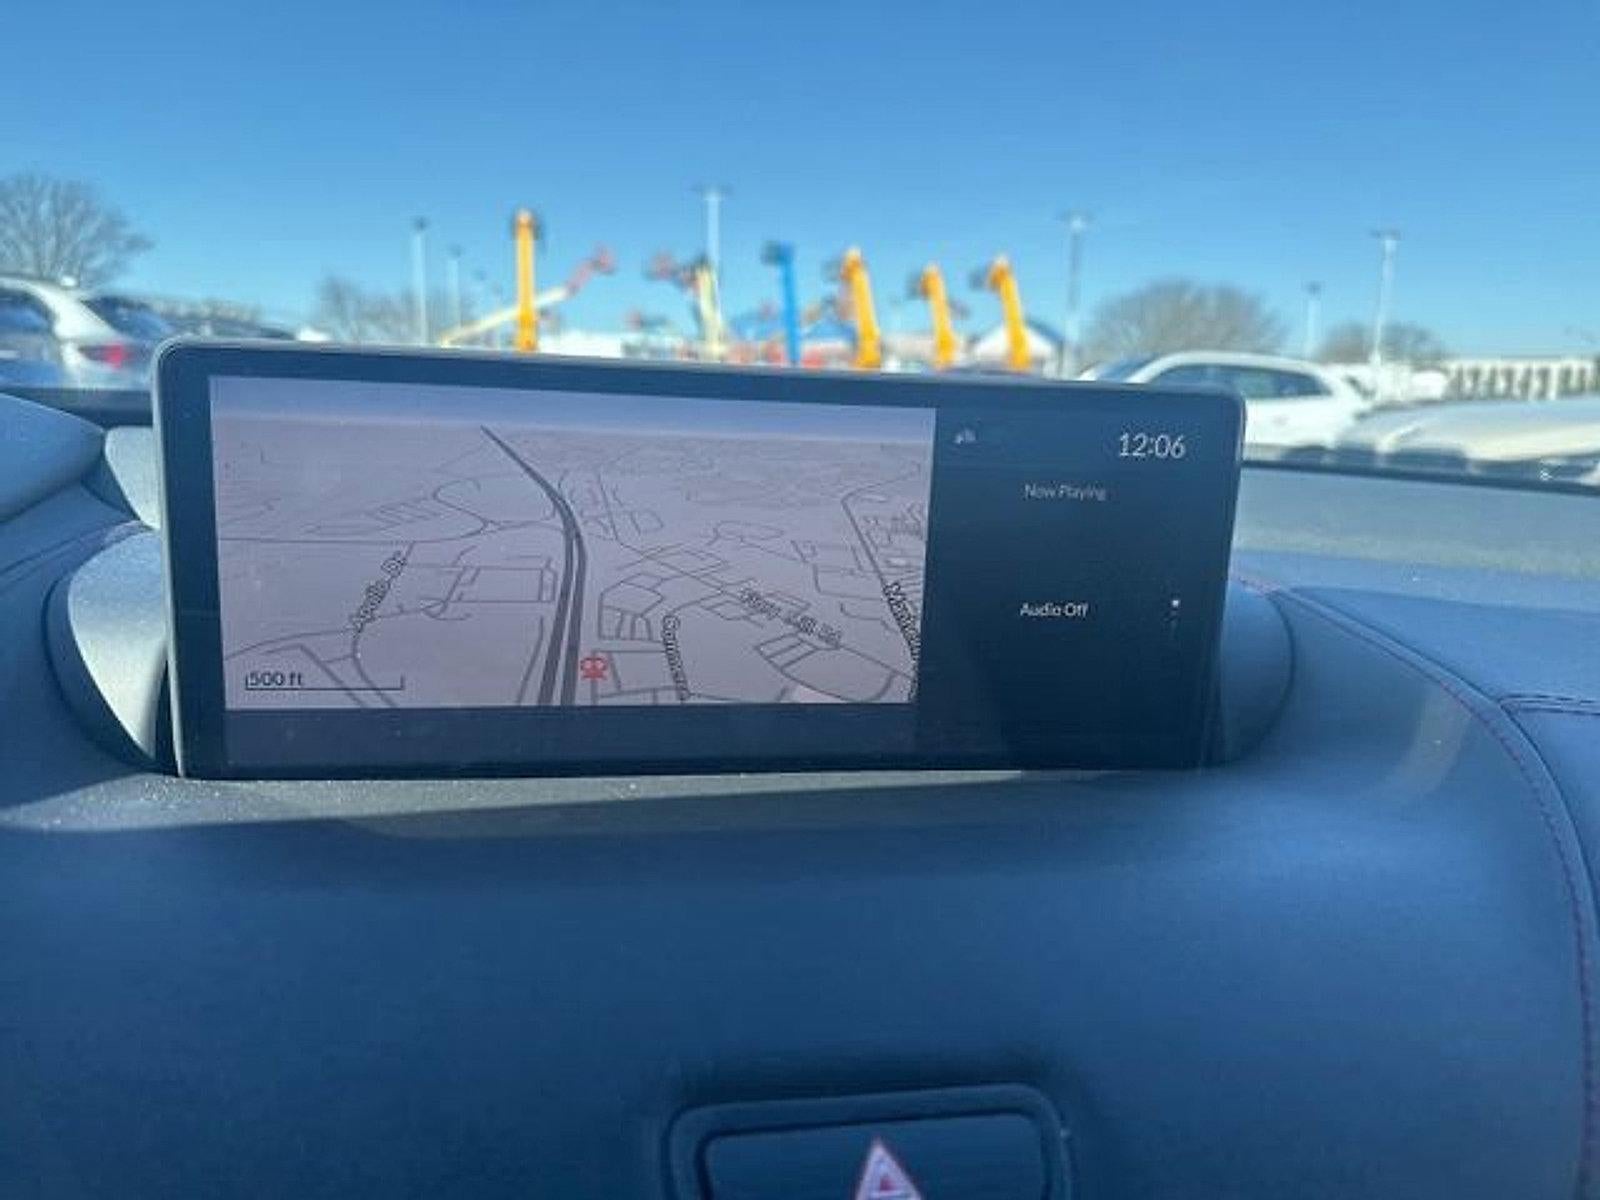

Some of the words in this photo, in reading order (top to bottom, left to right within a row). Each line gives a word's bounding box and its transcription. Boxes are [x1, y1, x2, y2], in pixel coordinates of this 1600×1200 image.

[1119, 432, 1186, 459] 12:06
[1024, 484, 1056, 499] Now
[1059, 484, 1106, 502] Playing
[1020, 602, 1061, 617] Audio
[1064, 602, 1089, 617] Off
[248, 671, 285, 687] 500
[289, 671, 303, 687] ft
